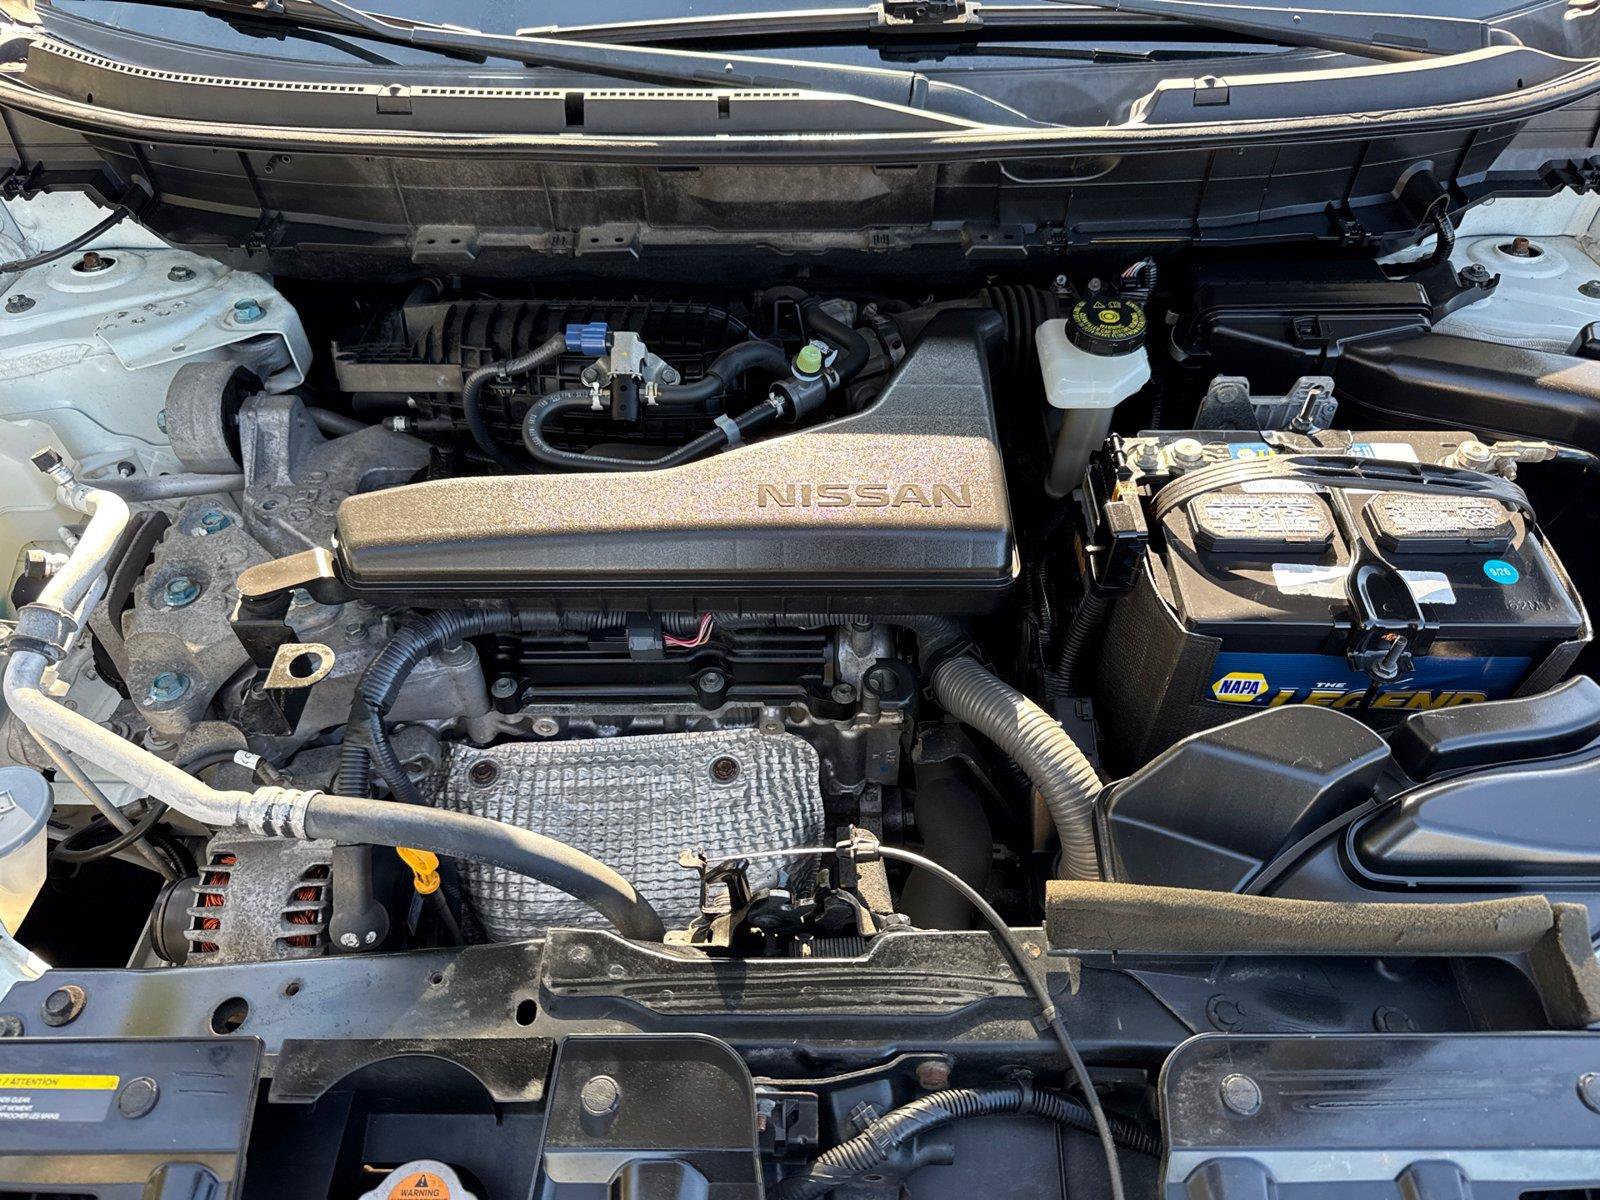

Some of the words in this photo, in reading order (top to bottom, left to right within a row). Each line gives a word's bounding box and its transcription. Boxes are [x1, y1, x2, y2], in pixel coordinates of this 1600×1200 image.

[757, 483, 972, 508] NISSAN
[1489, 567, 1511, 577] 9/26
[1219, 680, 1260, 694] NAPA
[10, 1077, 59, 1086] ATTENTION
[400, 1189, 439, 1197] WARNING
